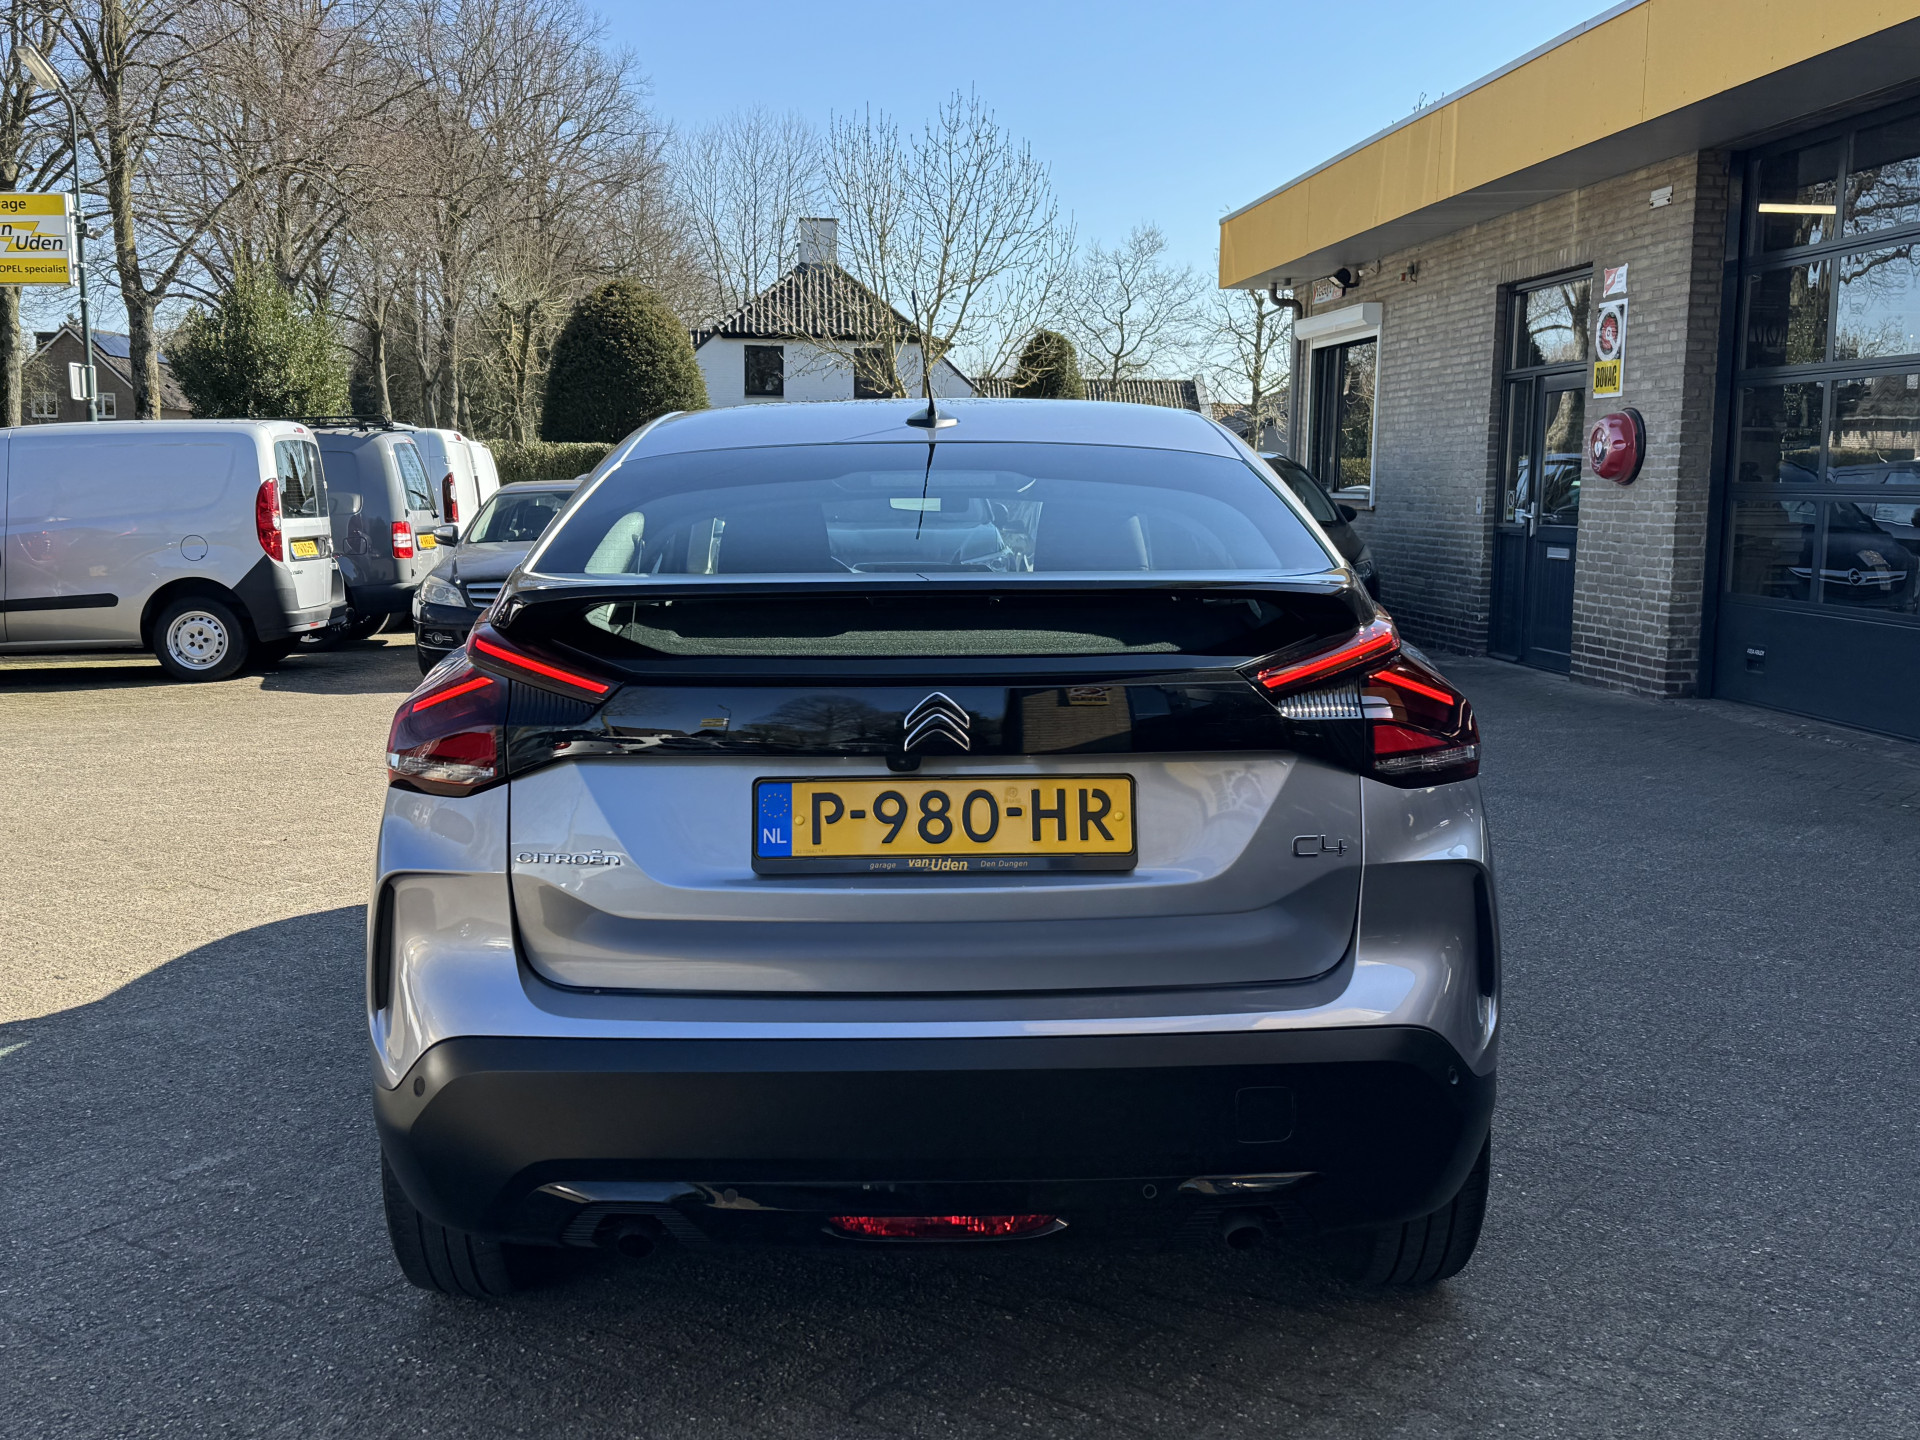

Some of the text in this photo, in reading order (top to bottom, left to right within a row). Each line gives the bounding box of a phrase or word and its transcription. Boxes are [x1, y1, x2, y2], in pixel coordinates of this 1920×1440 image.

[15, 235, 63, 250] Uden
[0, 264, 67, 274] OPEL specialist
[1595, 365, 1617, 388] BOVAG
[811, 788, 1114, 845] P-980-HR
[763, 828, 787, 844] NL
[1292, 834, 1348, 857] C4
[869, 858, 1028, 871] garage van Uden Den Dungen
